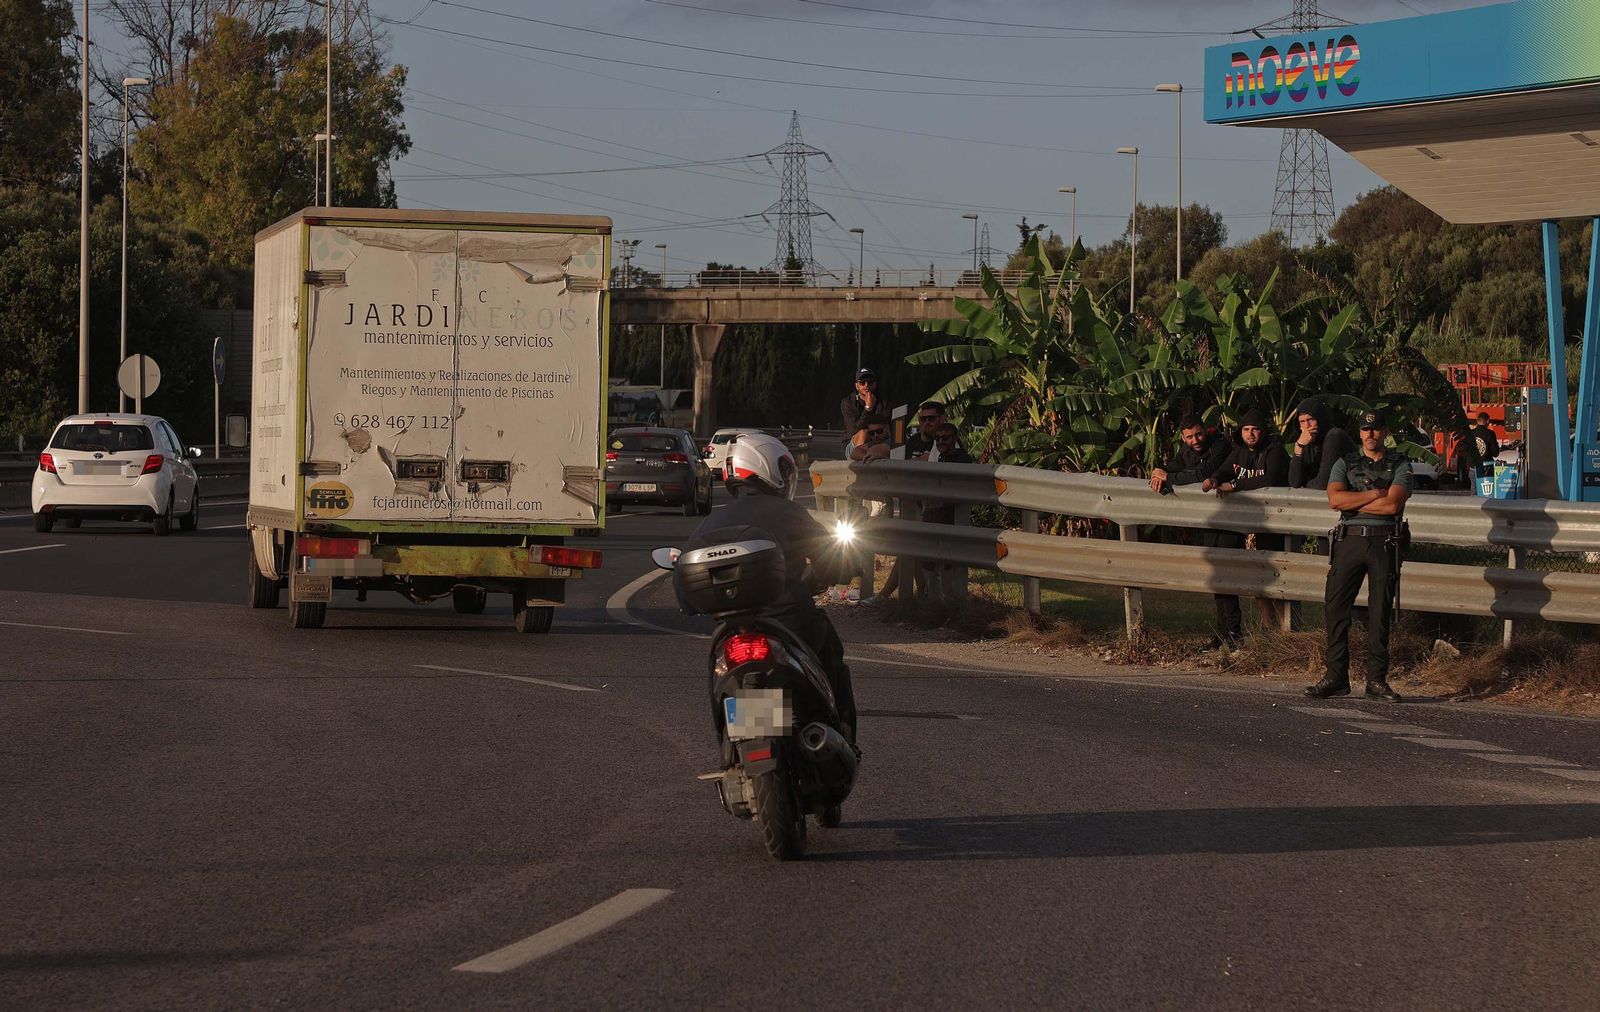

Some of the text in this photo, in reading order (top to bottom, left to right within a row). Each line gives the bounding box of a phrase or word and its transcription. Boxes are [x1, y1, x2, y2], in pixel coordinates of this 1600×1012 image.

[1225, 34, 1361, 110] moeve
[431, 289, 487, 303] F C
[344, 303, 577, 331] JARDINEROS
[364, 331, 554, 350] mantenimientos y servicios
[340, 367, 426, 380] Mantenimientos
[429, 371, 437, 383] y
[439, 369, 512, 382] Realizaciones
[515, 371, 529, 383] de
[361, 384, 555, 399] Riegos y Mantenimiento de Piscinas
[350, 414, 450, 430] 628 467 112
[373, 496, 543, 511] fcjardineros@hotmail.com
[707, 548, 737, 559] SHAD
